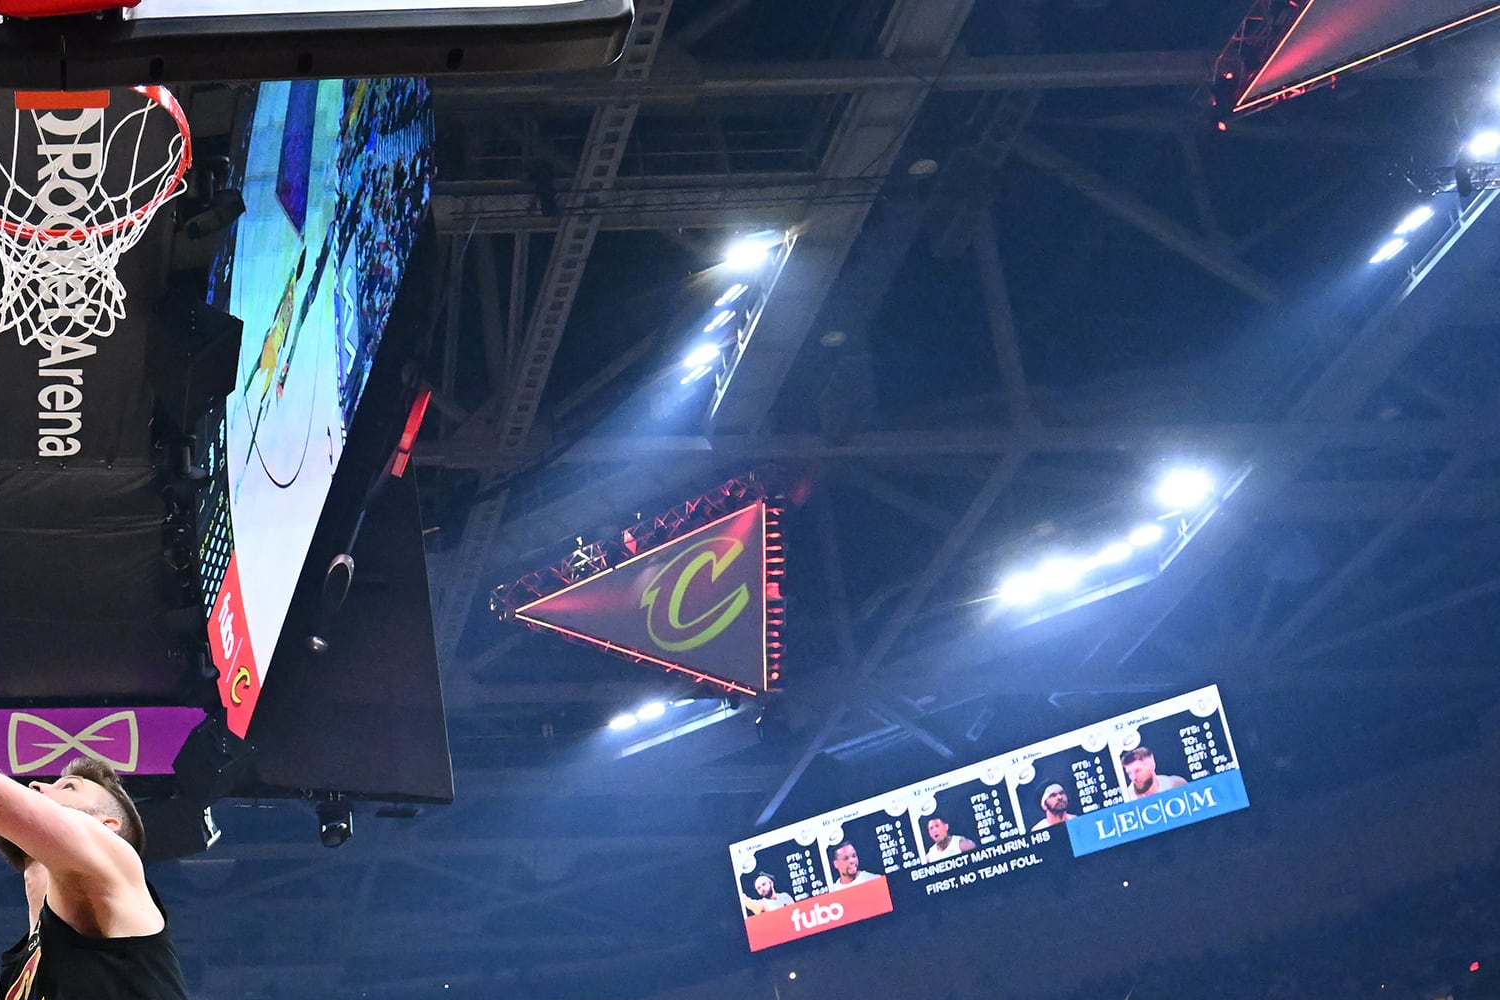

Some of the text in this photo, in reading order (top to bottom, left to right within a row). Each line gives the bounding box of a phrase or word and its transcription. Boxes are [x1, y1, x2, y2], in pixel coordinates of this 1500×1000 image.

[36, 336, 99, 457] Arena
[910, 855, 969, 881] BENNEDICT
[971, 838, 1029, 863] MATHURIN,
[1030, 831, 1050, 845] HIS
[926, 854, 1043, 895] FIRST, NO TEAM FOUL.
[790, 902, 844, 932] fubo
